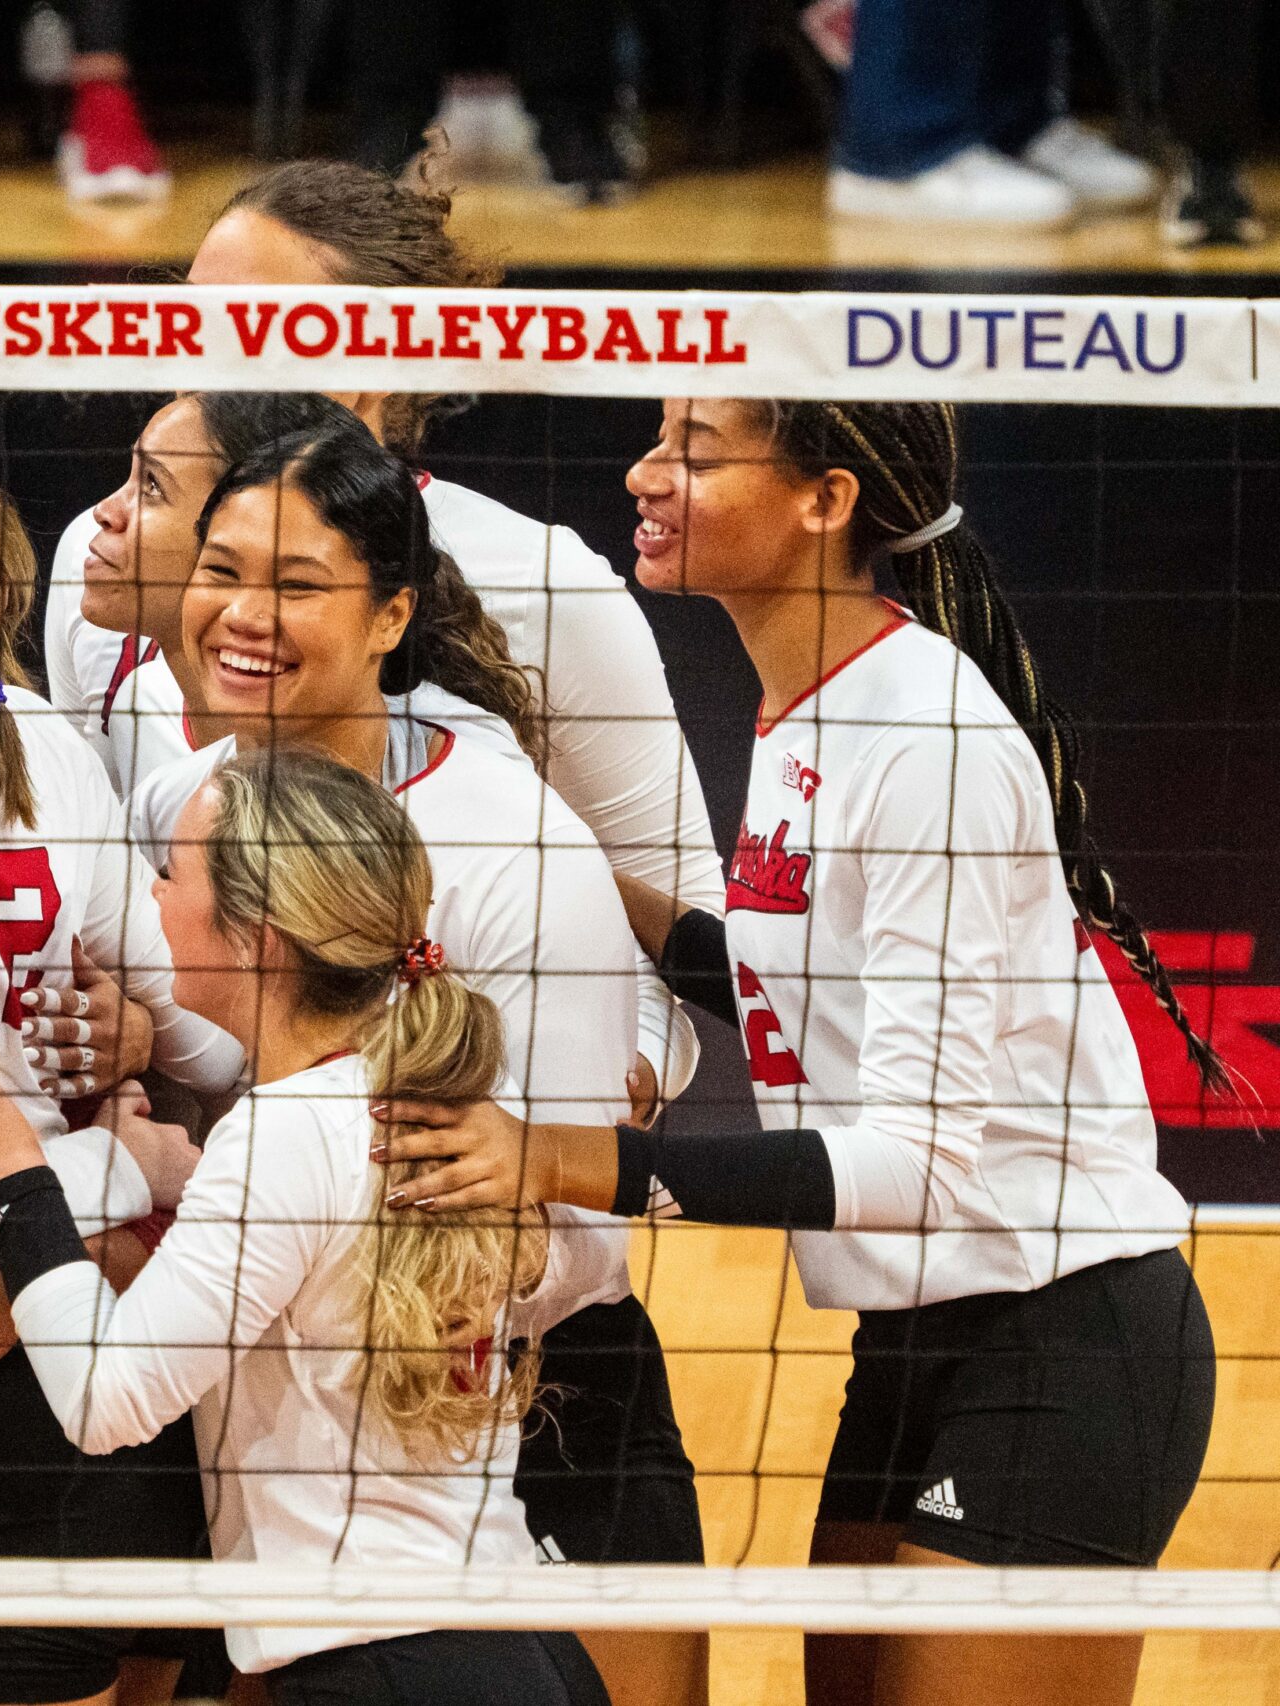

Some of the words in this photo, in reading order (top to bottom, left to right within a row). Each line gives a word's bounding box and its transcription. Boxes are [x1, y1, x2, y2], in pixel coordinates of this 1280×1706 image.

[226, 303, 747, 364] VOLLEYBALL
[848, 308, 1185, 374] DUTEAU
[916, 1497, 964, 1520] adidas
